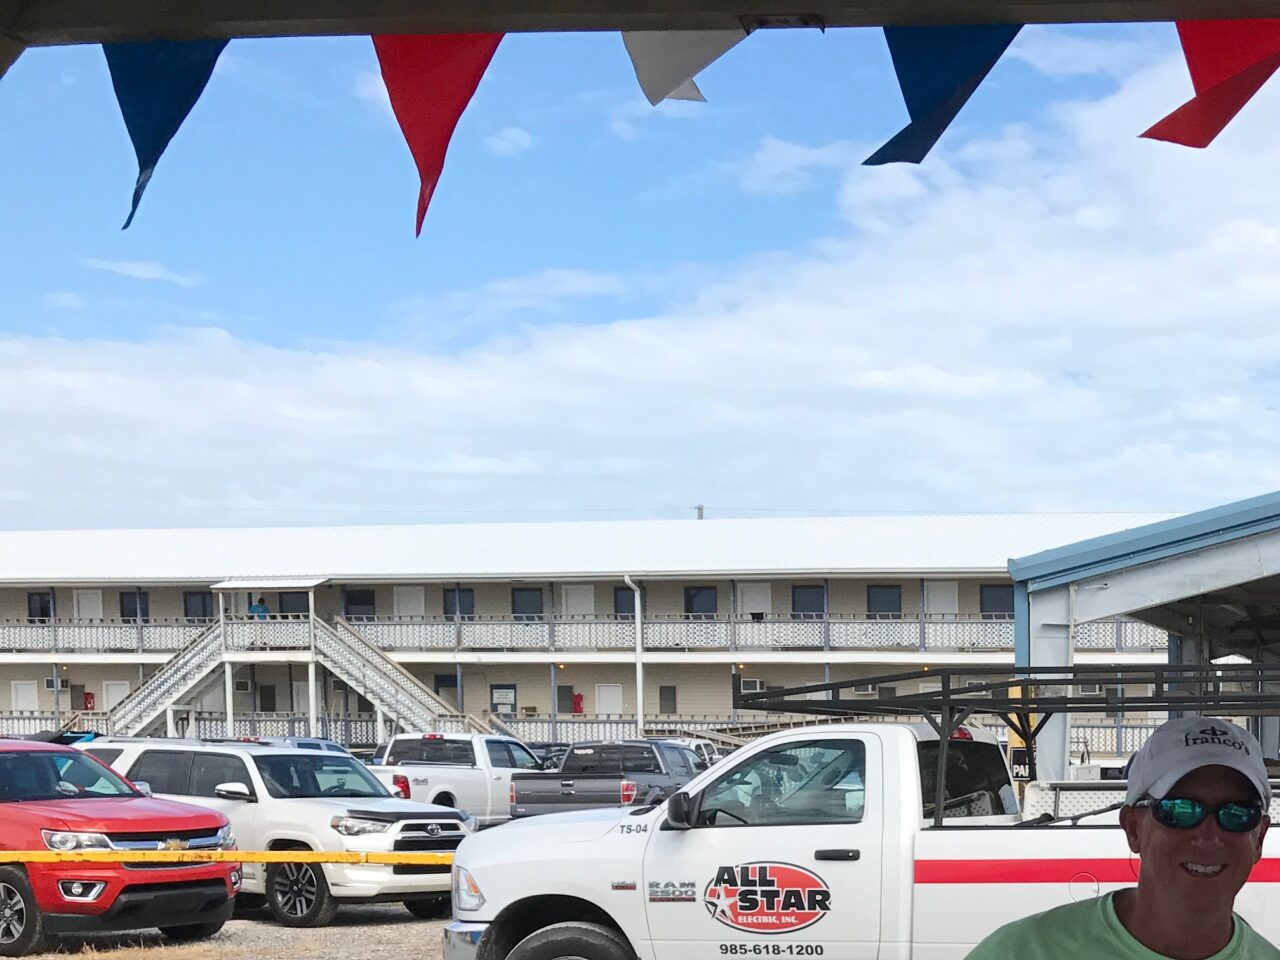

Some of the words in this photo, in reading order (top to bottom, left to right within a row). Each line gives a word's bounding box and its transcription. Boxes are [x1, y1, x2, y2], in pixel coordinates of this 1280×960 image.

[1184, 732, 1251, 756] franco's
[619, 823, 648, 835] TS-04
[713, 866, 777, 887] ALL
[648, 881, 697, 889] RAM
[648, 889, 697, 897] 2500
[737, 889, 831, 911] STAR
[737, 915, 780, 925] ELECTRIC,
[781, 915, 799, 924] INC.
[719, 943, 824, 956] 985-618-1200
